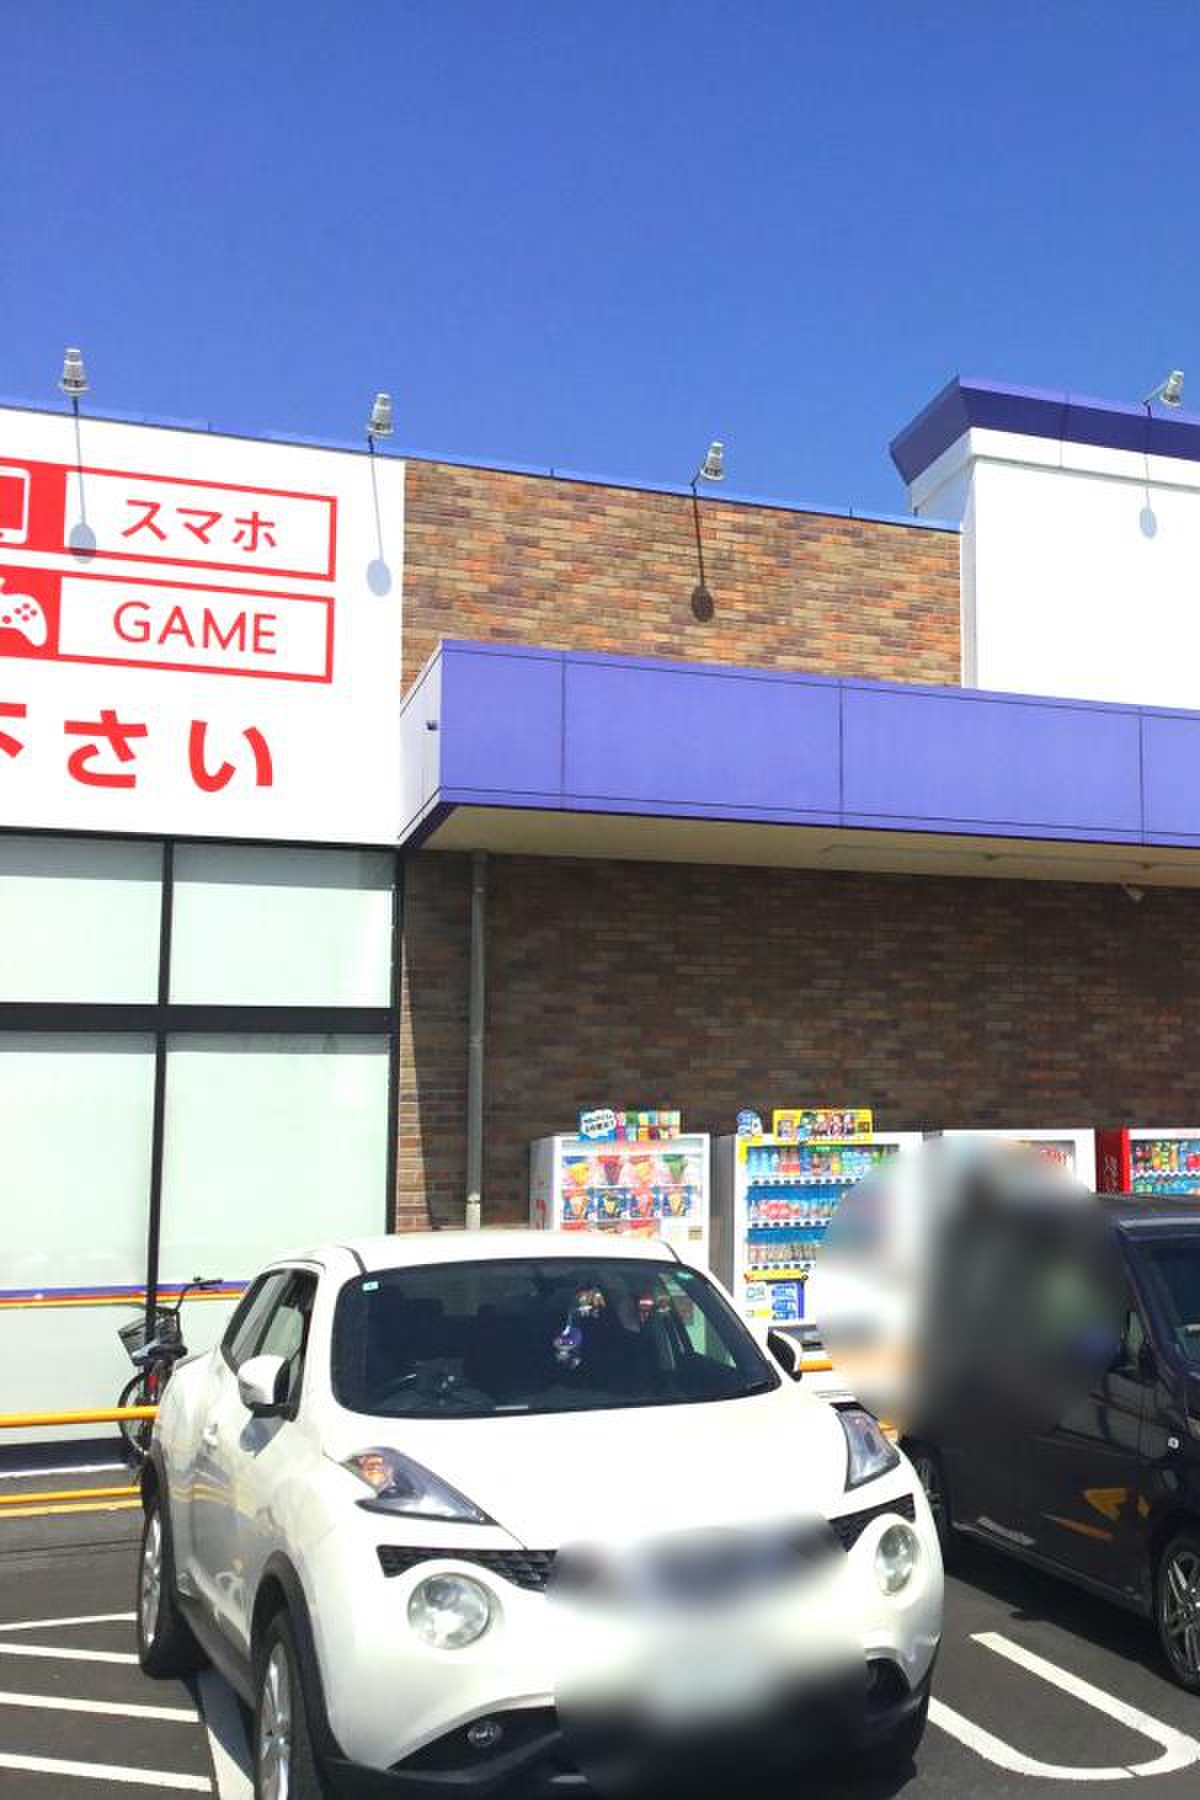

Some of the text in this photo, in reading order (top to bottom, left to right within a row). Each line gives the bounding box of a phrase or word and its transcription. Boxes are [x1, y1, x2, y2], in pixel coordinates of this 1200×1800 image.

[121, 499, 278, 552] スマホ
[113, 601, 277, 654] GAME
